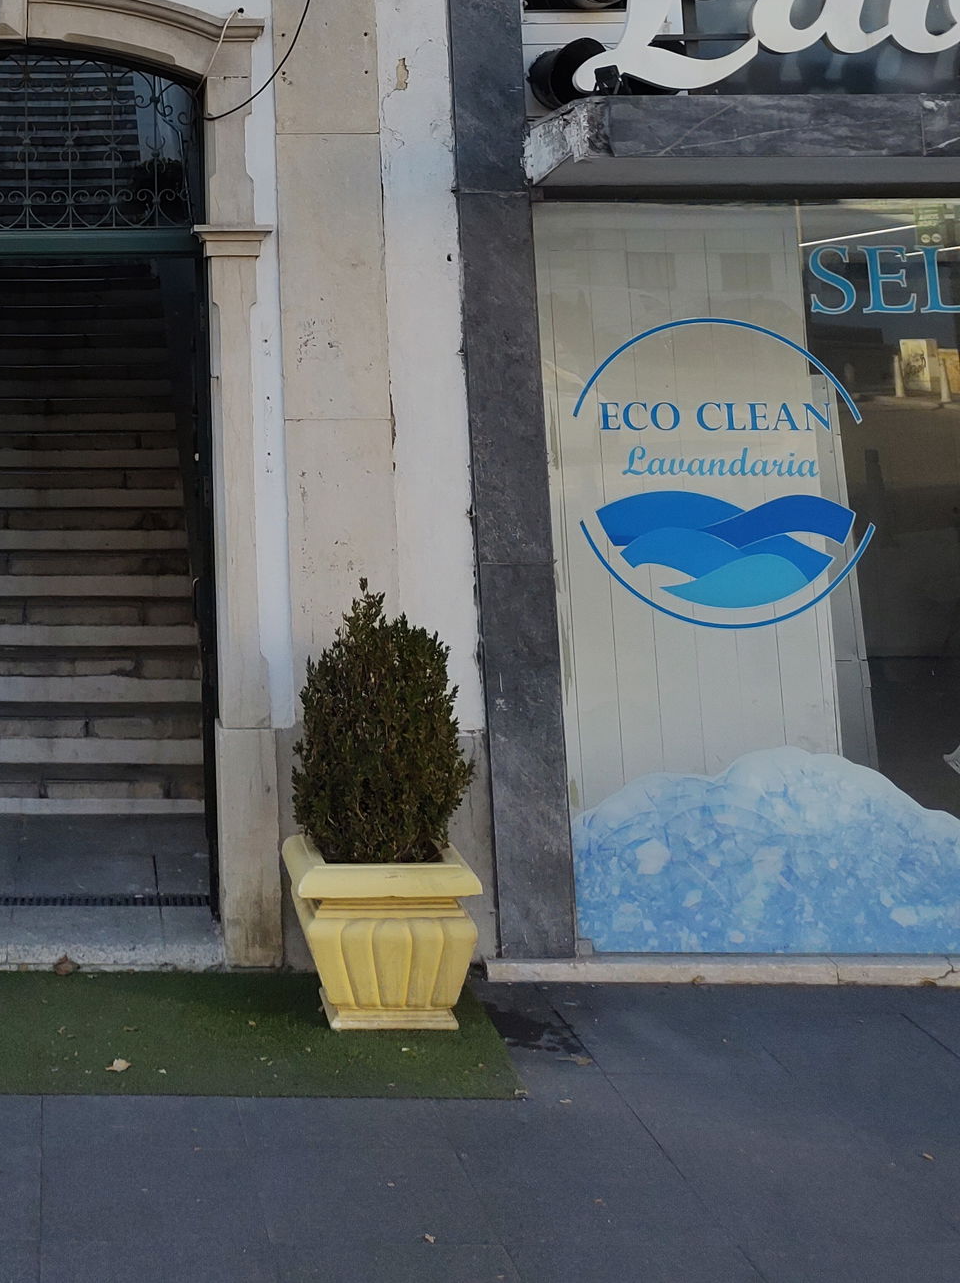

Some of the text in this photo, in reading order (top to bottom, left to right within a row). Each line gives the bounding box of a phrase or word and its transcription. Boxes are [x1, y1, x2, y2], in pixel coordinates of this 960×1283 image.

[808, 244, 960, 316] SEL
[598, 401, 832, 432] ECO CLEAN
[622, 445, 819, 478] Lavandaria
